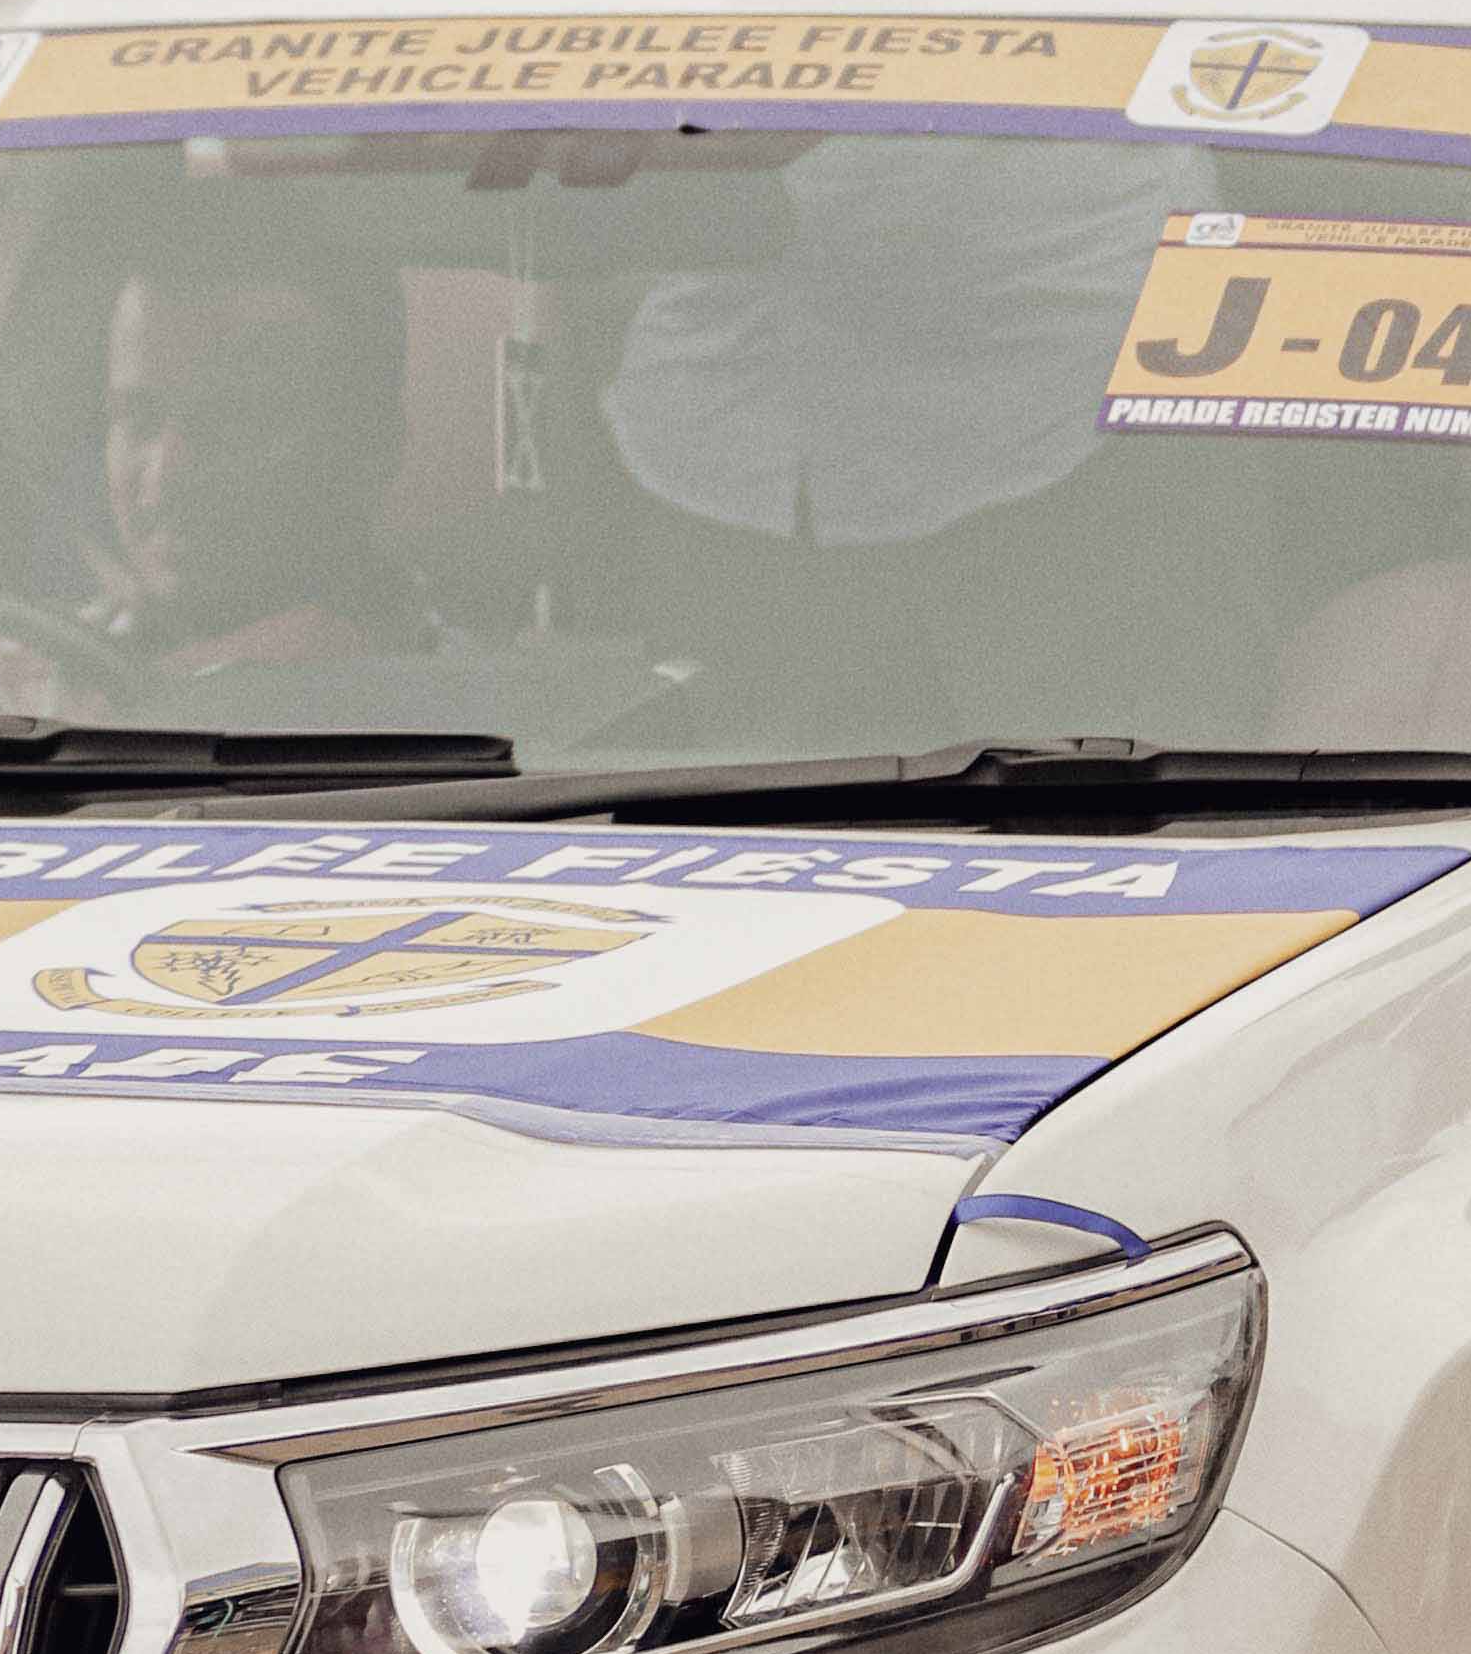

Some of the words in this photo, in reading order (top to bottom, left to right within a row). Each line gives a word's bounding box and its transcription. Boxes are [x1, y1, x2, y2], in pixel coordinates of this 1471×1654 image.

[111, 28, 435, 68] GRANITE
[456, 25, 777, 54] JUBILEE
[798, 25, 1058, 58] FIESTA
[246, 61, 562, 98] VEHICLE
[581, 60, 886, 90] PARADE
[1106, 397, 1239, 426] PARADE
[1239, 400, 1397, 432] REGISTER
[505, 843, 1178, 899] FIESTA
